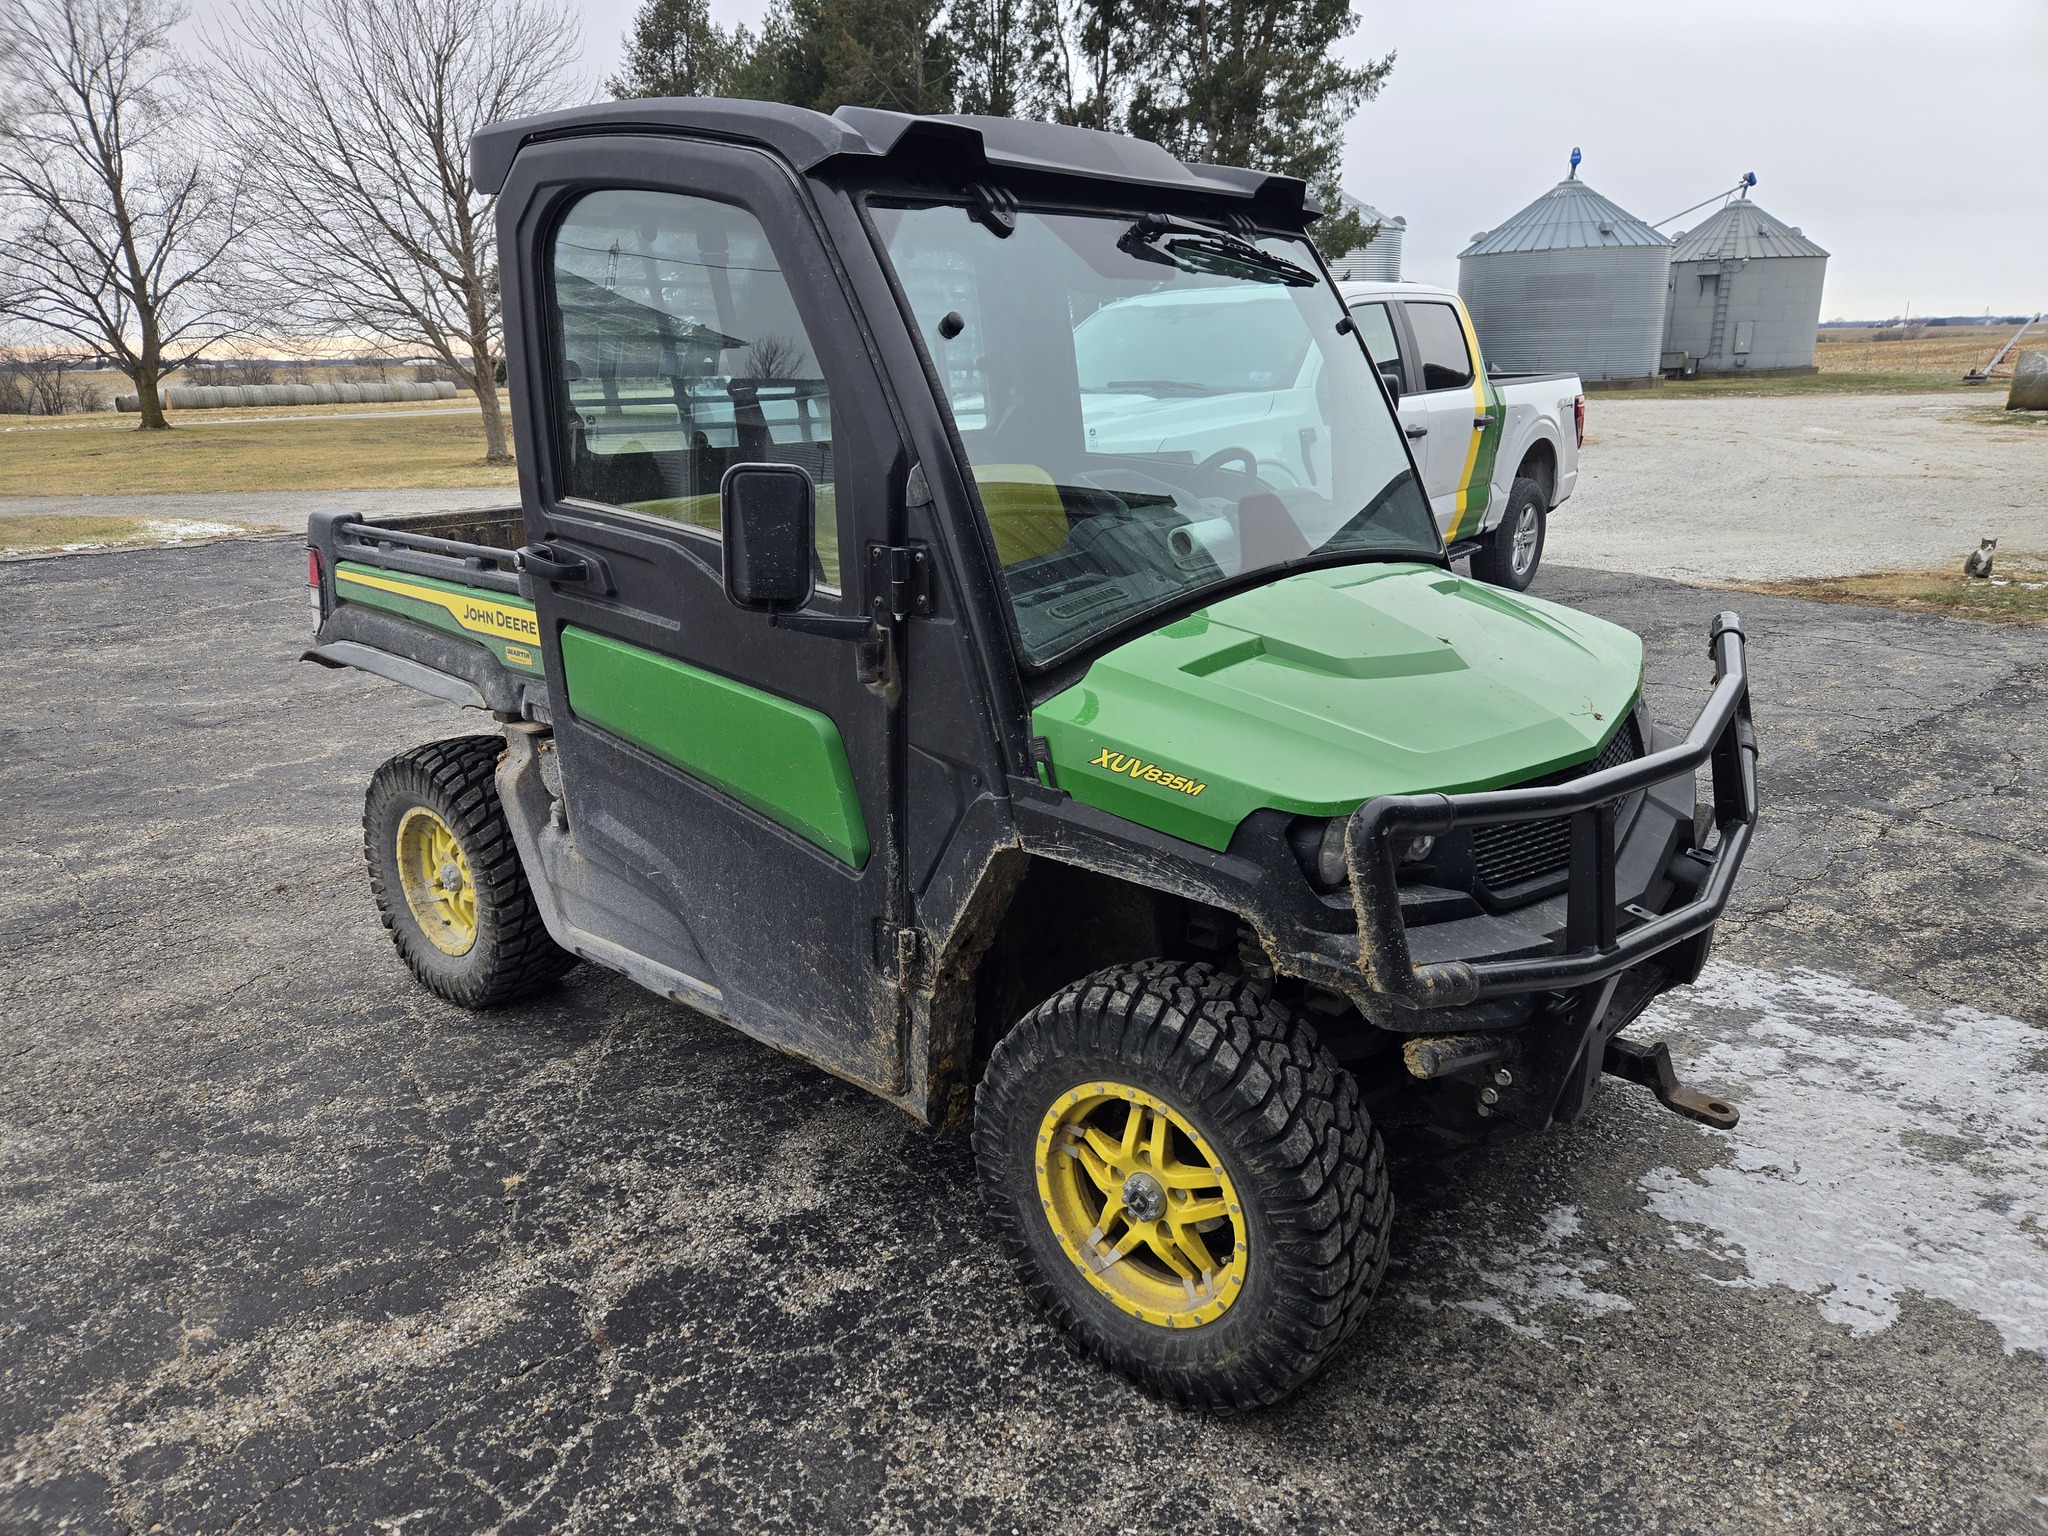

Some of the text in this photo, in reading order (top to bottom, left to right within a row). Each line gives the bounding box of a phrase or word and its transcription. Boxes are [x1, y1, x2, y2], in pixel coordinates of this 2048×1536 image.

[464, 604, 537, 635] JOHN DEERE
[1087, 747, 1208, 797] XUV835M
